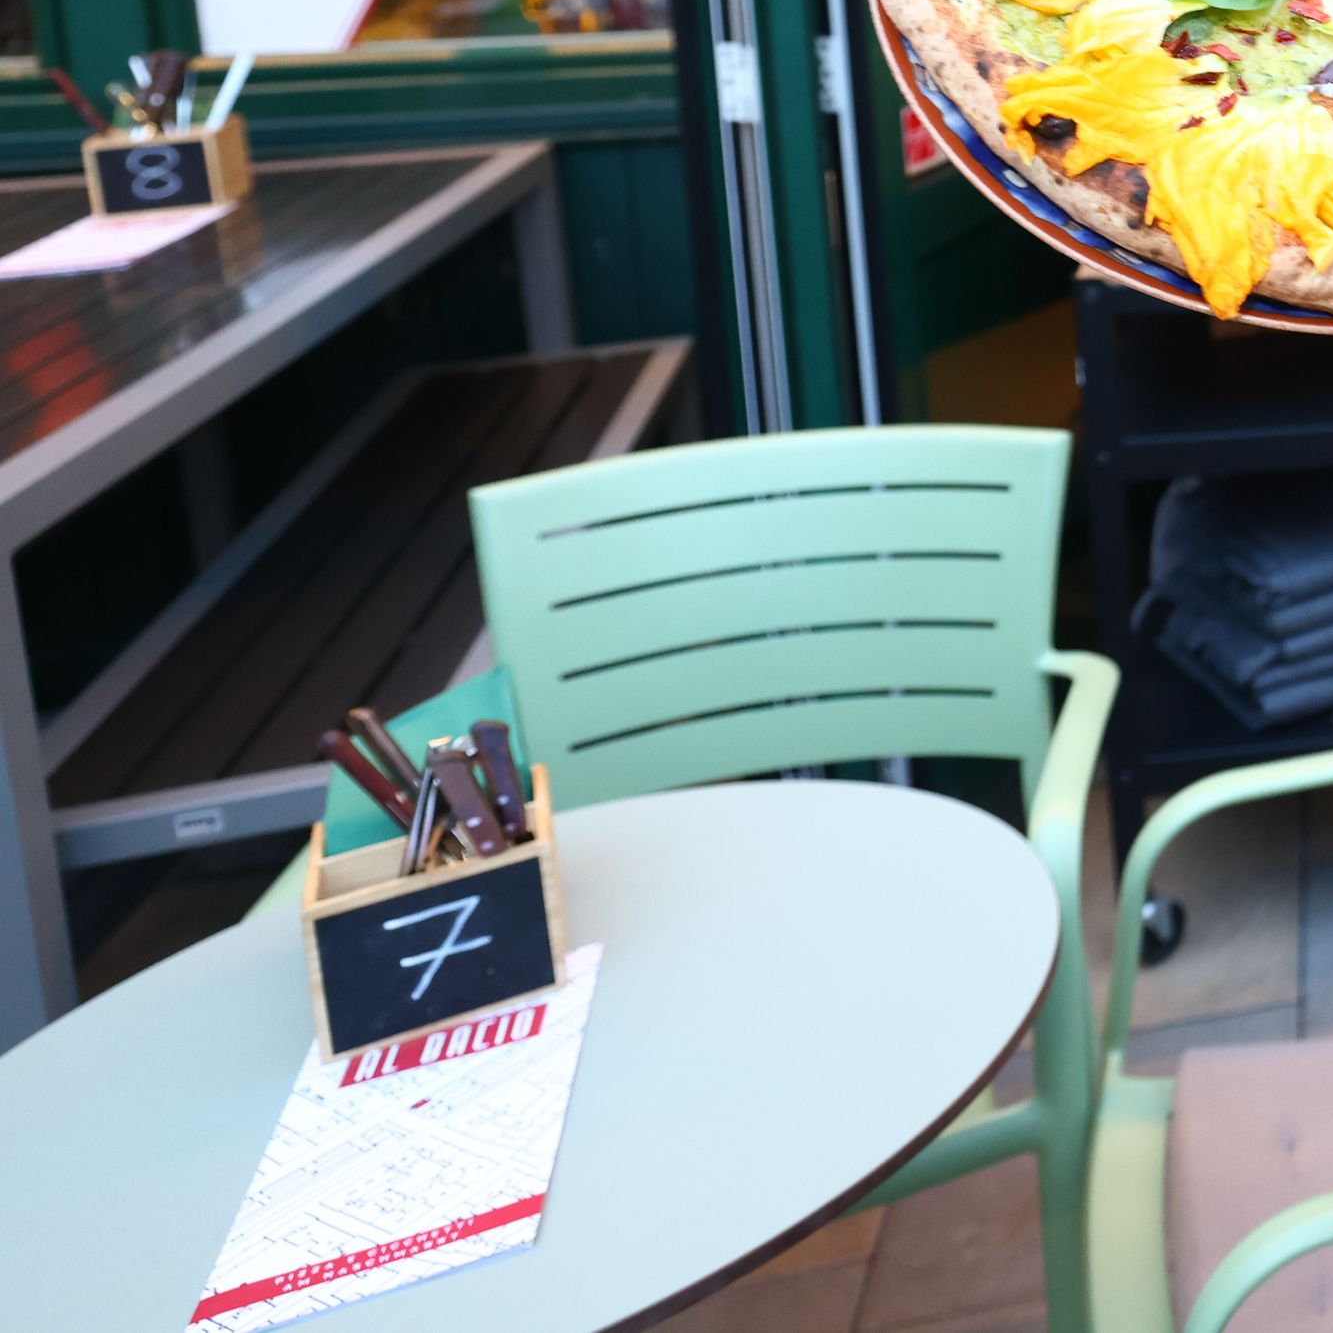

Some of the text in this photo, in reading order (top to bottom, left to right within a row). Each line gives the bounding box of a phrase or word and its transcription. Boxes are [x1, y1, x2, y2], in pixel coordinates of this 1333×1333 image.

[125, 144, 184, 200] 8
[383, 895, 493, 1000] 7
[353, 1007, 536, 1083] AL BACIO
